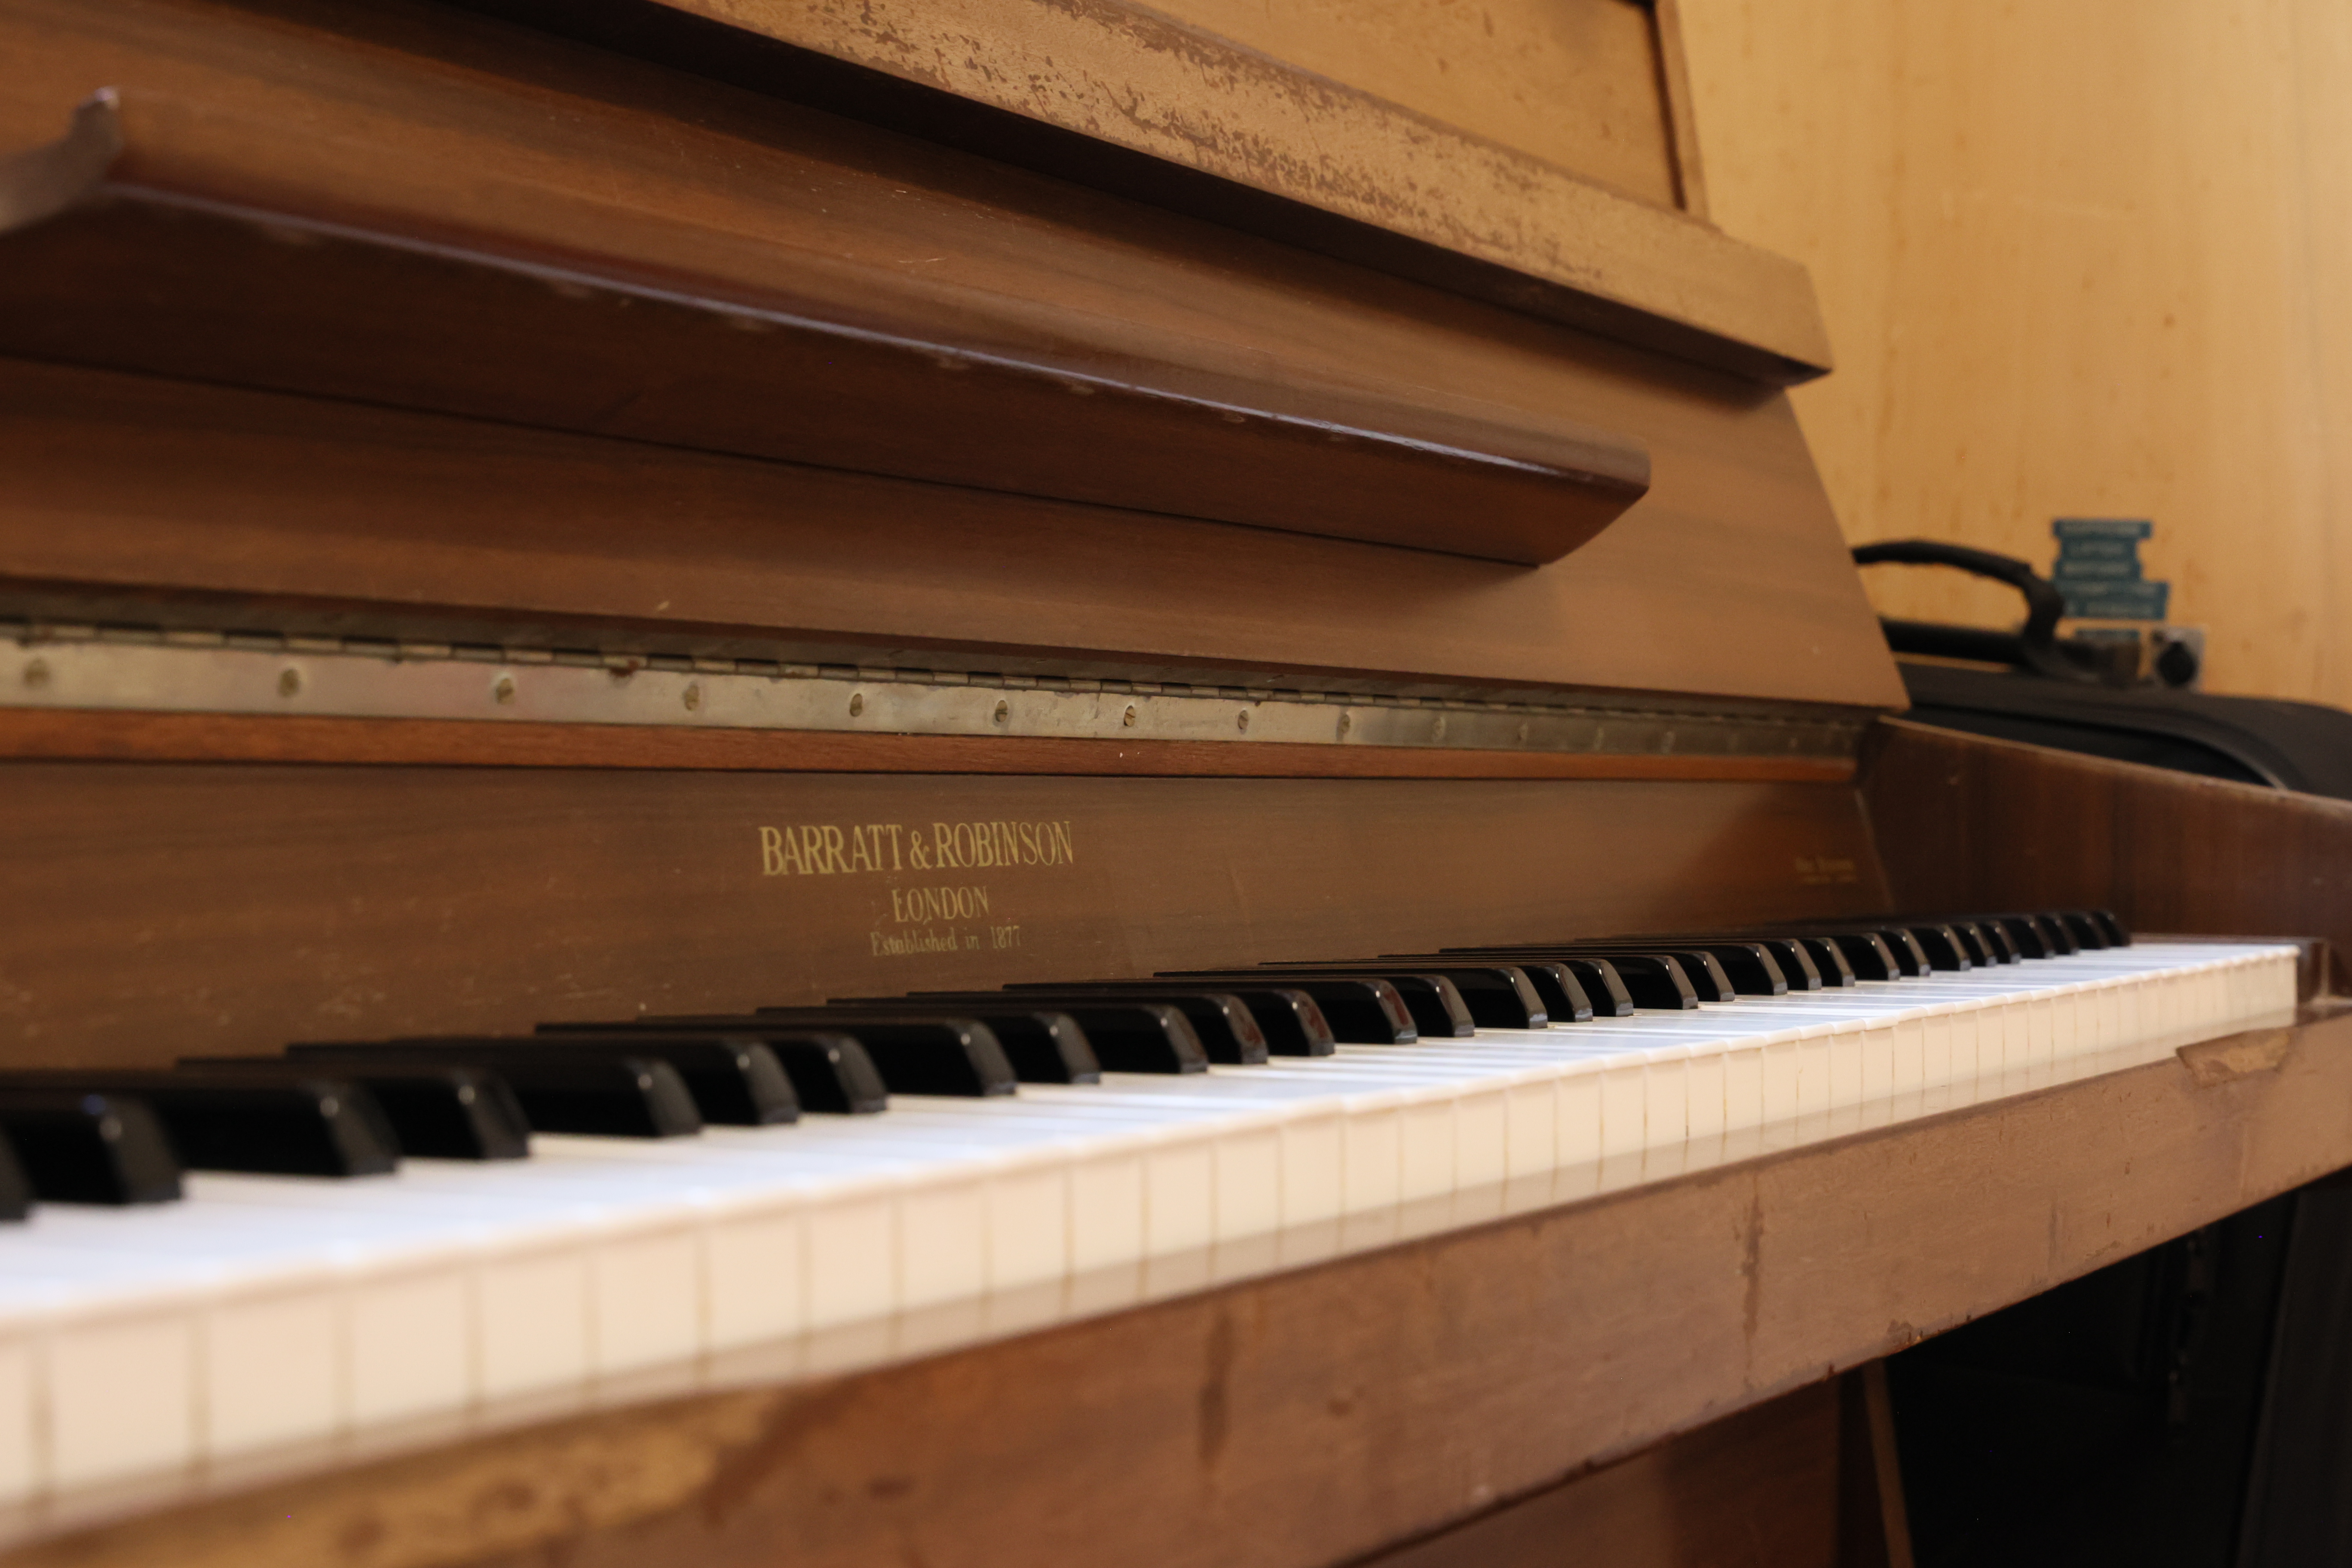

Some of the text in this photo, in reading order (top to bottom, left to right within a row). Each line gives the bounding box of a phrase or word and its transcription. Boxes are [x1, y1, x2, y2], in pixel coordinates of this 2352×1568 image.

[759, 821, 1074, 876] BARRATT & ROBINSON
[891, 885, 990, 922] LONDON
[870, 925, 1020, 956] Established in 1877
